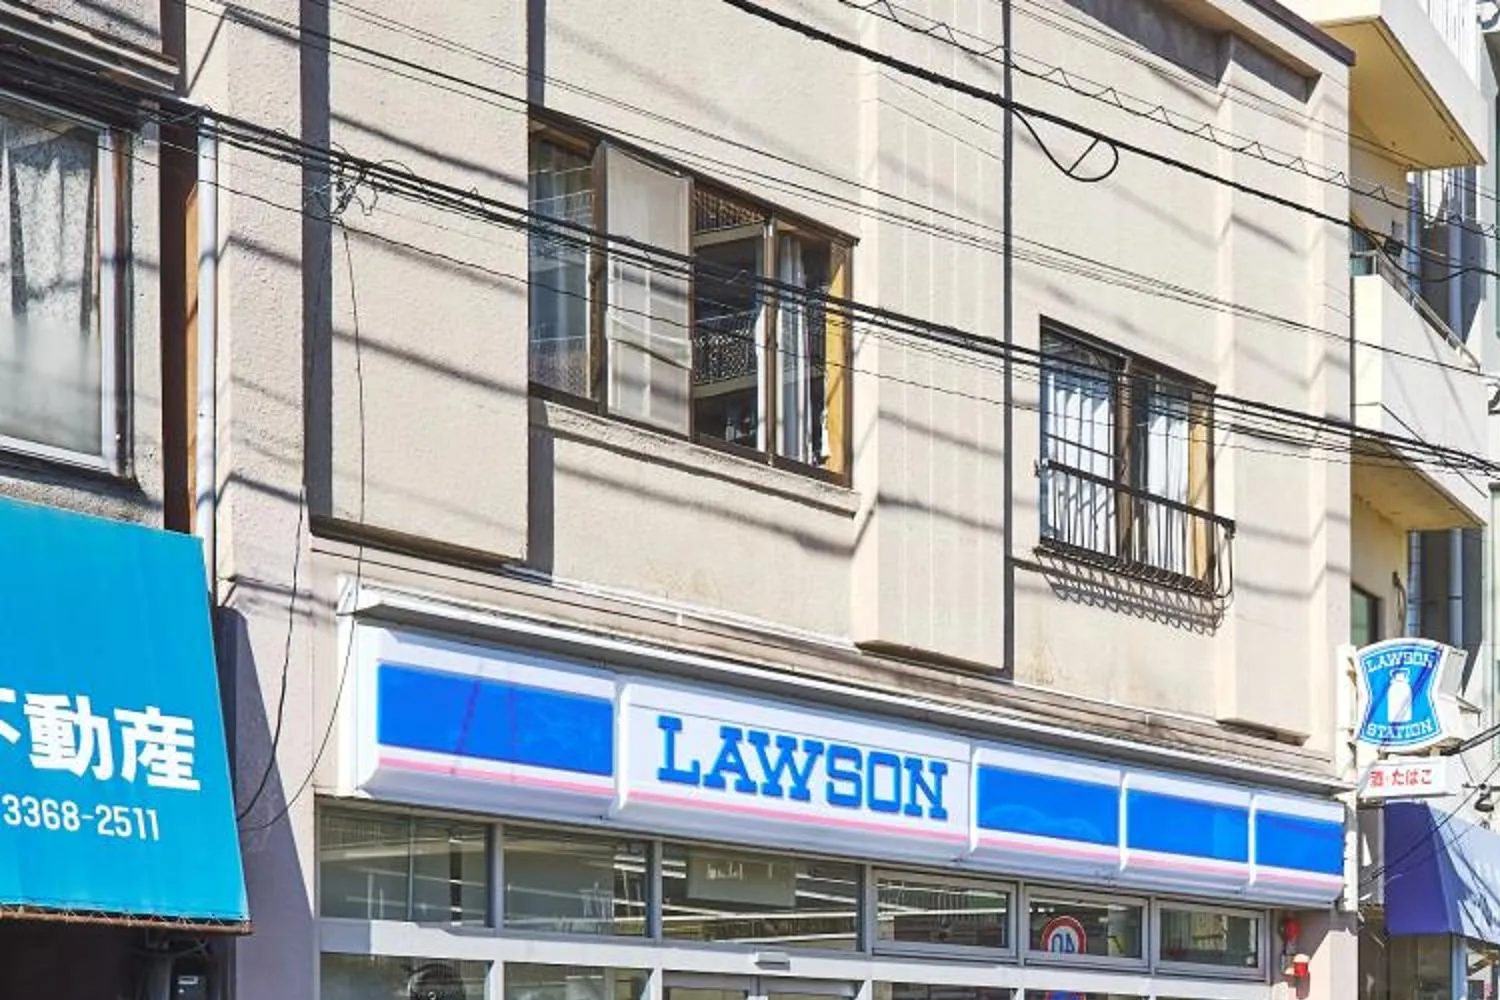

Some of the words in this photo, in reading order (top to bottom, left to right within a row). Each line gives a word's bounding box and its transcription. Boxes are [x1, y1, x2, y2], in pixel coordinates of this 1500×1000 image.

[1366, 651, 1434, 672] LAWSON
[0, 687, 200, 790] 動産
[1366, 719, 1433, 739] STATION
[657, 715, 948, 821] LAWSON
[2, 794, 159, 841] 3368-2511
